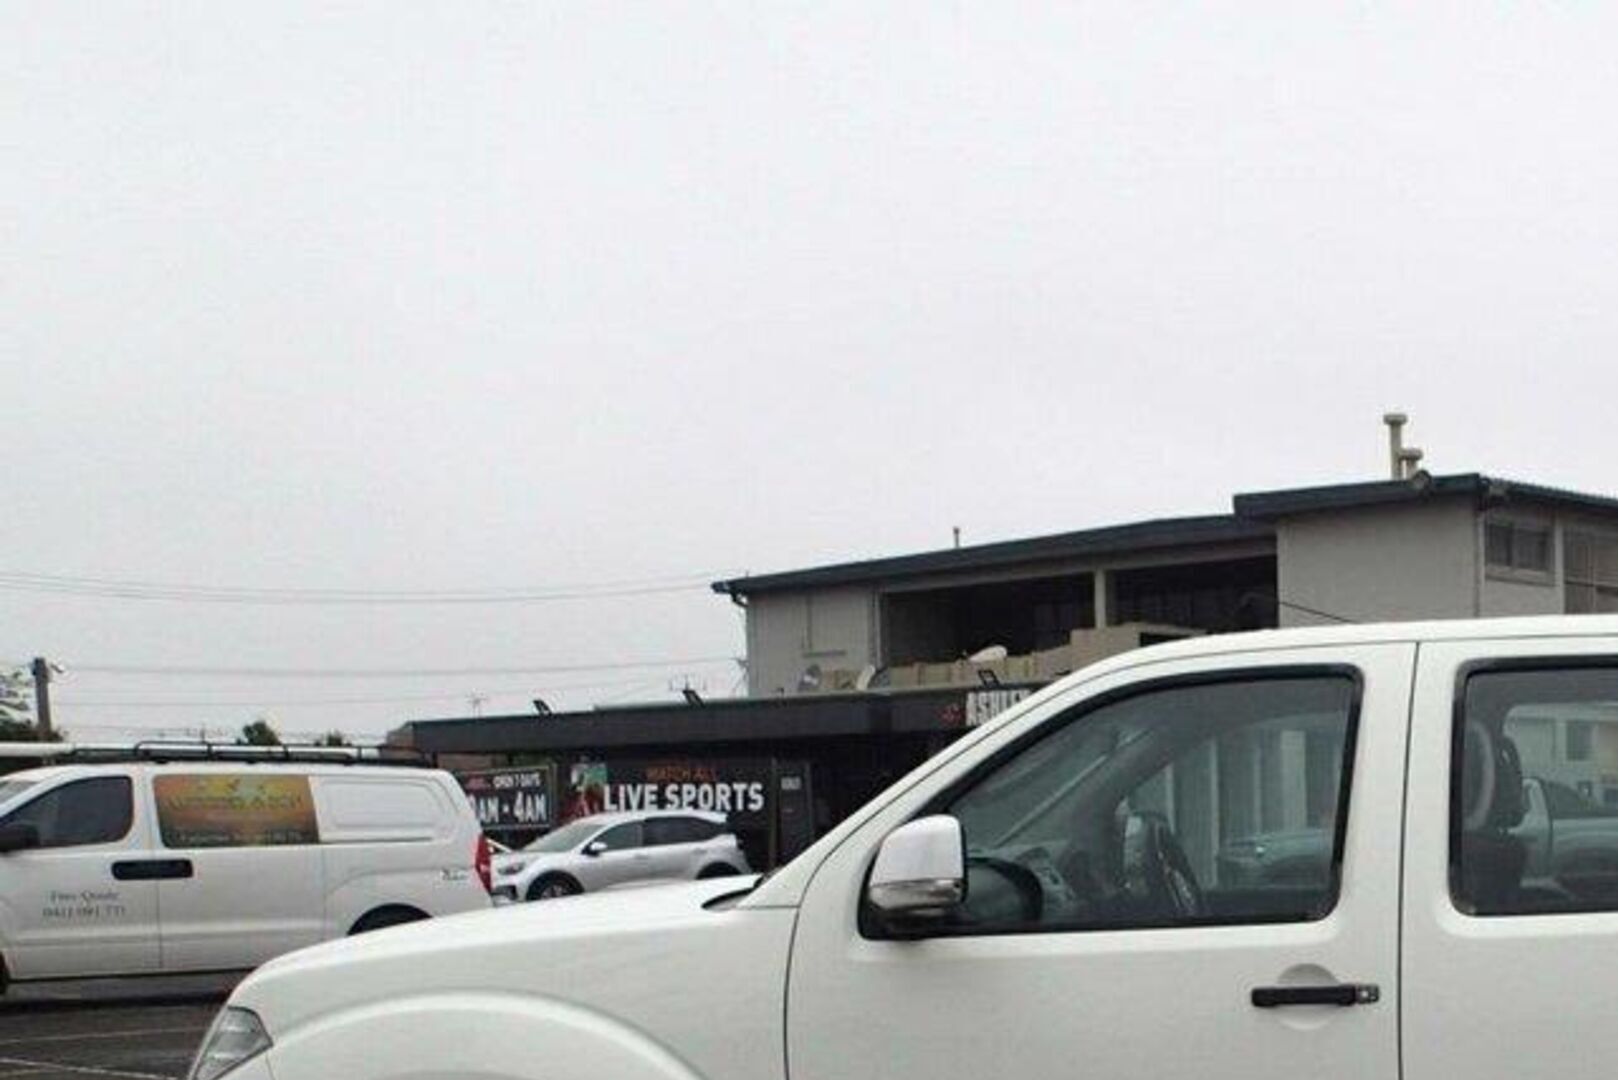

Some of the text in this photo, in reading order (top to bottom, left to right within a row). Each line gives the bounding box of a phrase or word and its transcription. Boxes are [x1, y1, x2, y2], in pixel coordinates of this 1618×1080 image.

[513, 791, 547, 823] 4AM
[603, 783, 660, 812] LIVE
[664, 782, 765, 812] SPORTS
